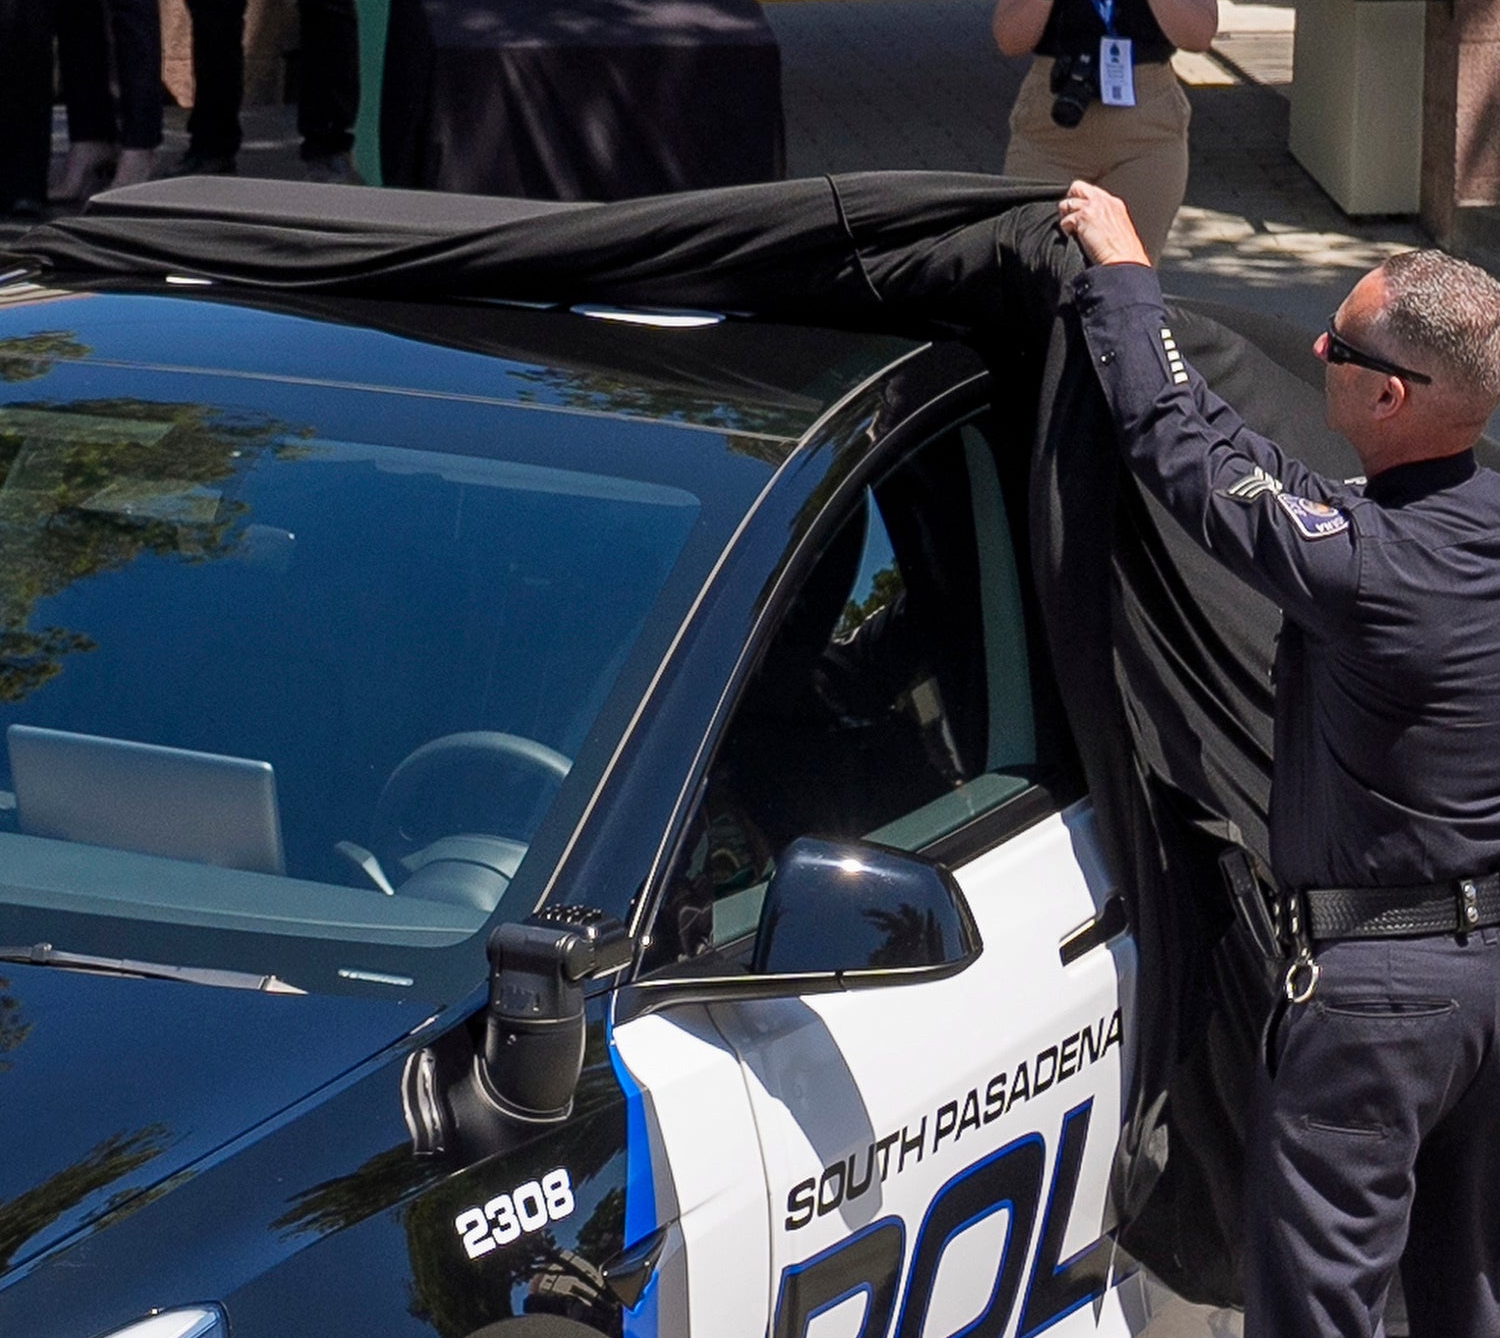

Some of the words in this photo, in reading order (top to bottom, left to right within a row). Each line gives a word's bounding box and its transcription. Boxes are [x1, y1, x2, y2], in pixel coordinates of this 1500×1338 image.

[784, 1113, 929, 1233] SOUTH
[931, 1005, 1126, 1155] PASADENA
[455, 1168, 576, 1260] 2308
